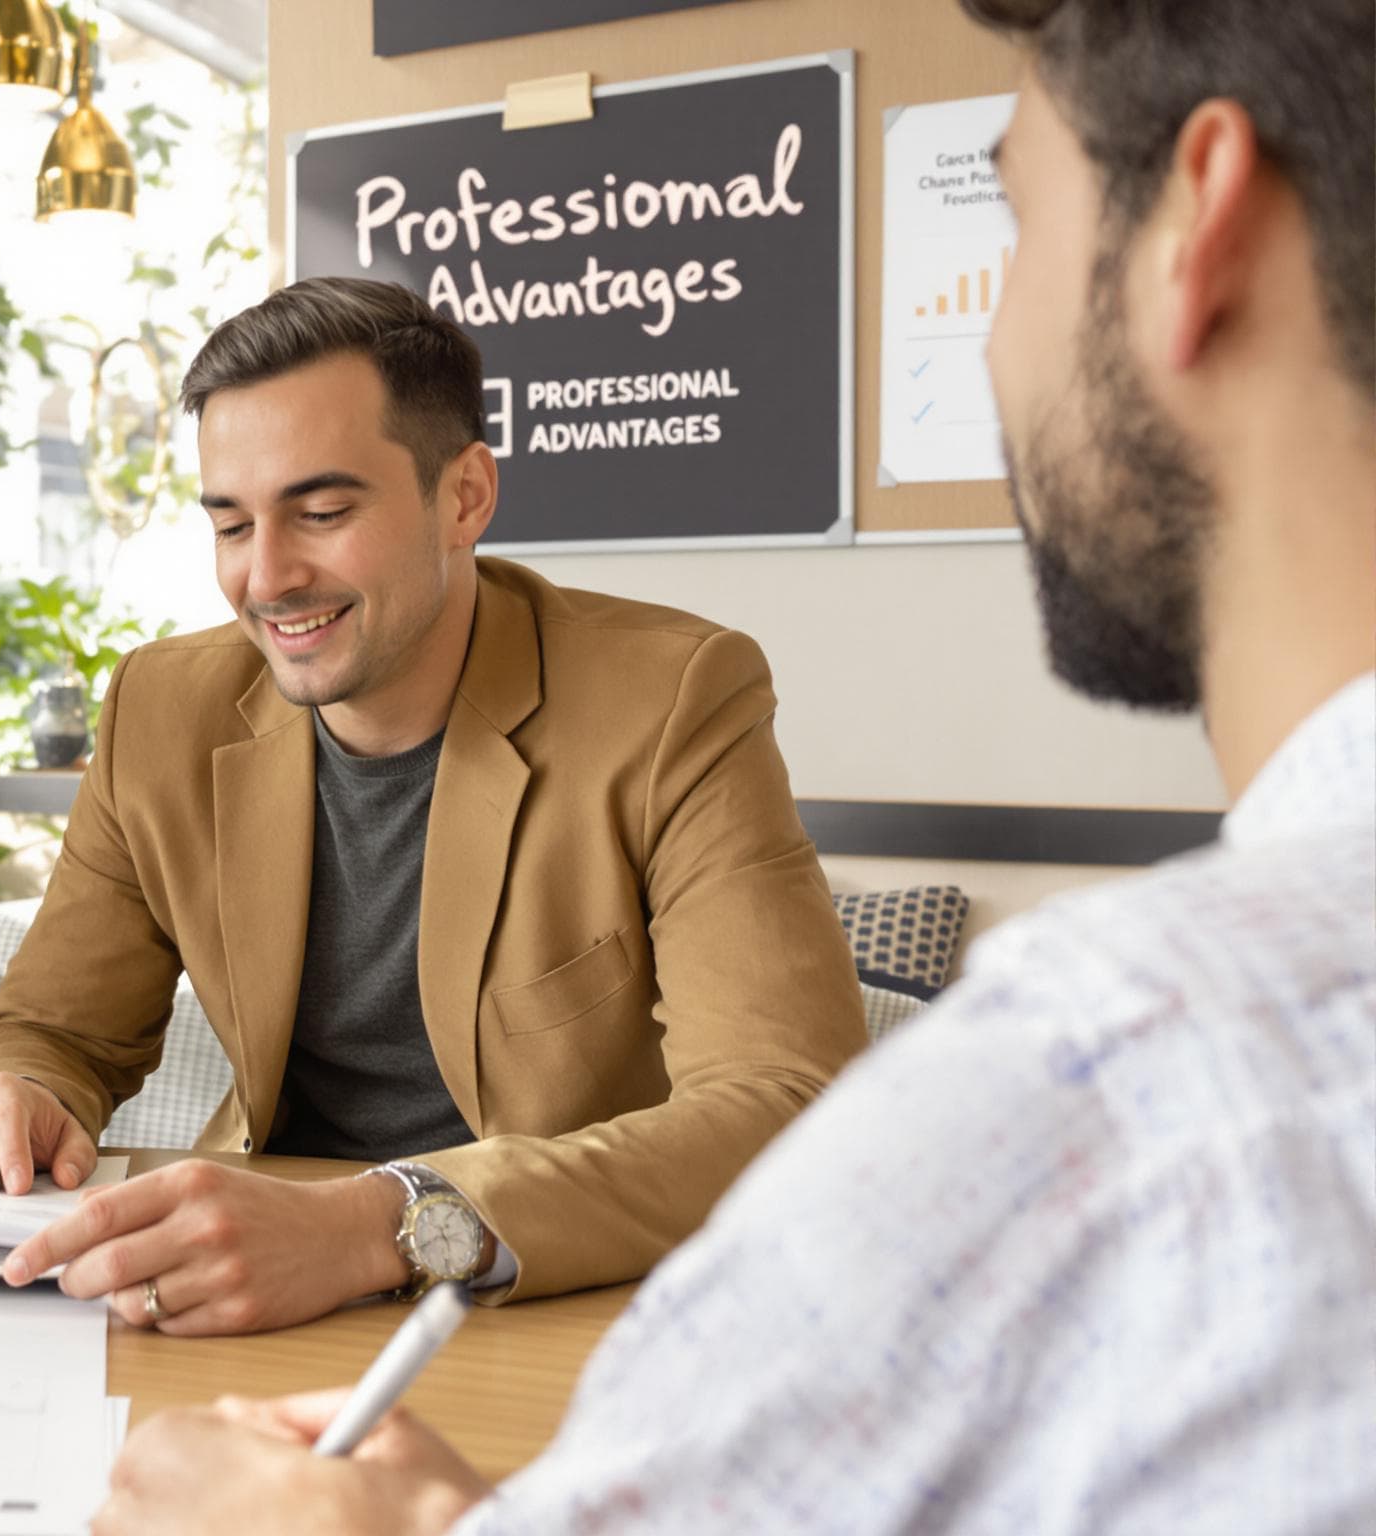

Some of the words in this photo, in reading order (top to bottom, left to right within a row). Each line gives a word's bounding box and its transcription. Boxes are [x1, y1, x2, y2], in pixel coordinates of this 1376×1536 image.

[428, 256, 742, 336] Advantages
[527, 368, 739, 410] PROFESSIONAL
[528, 414, 721, 453] ADVANTAGES
